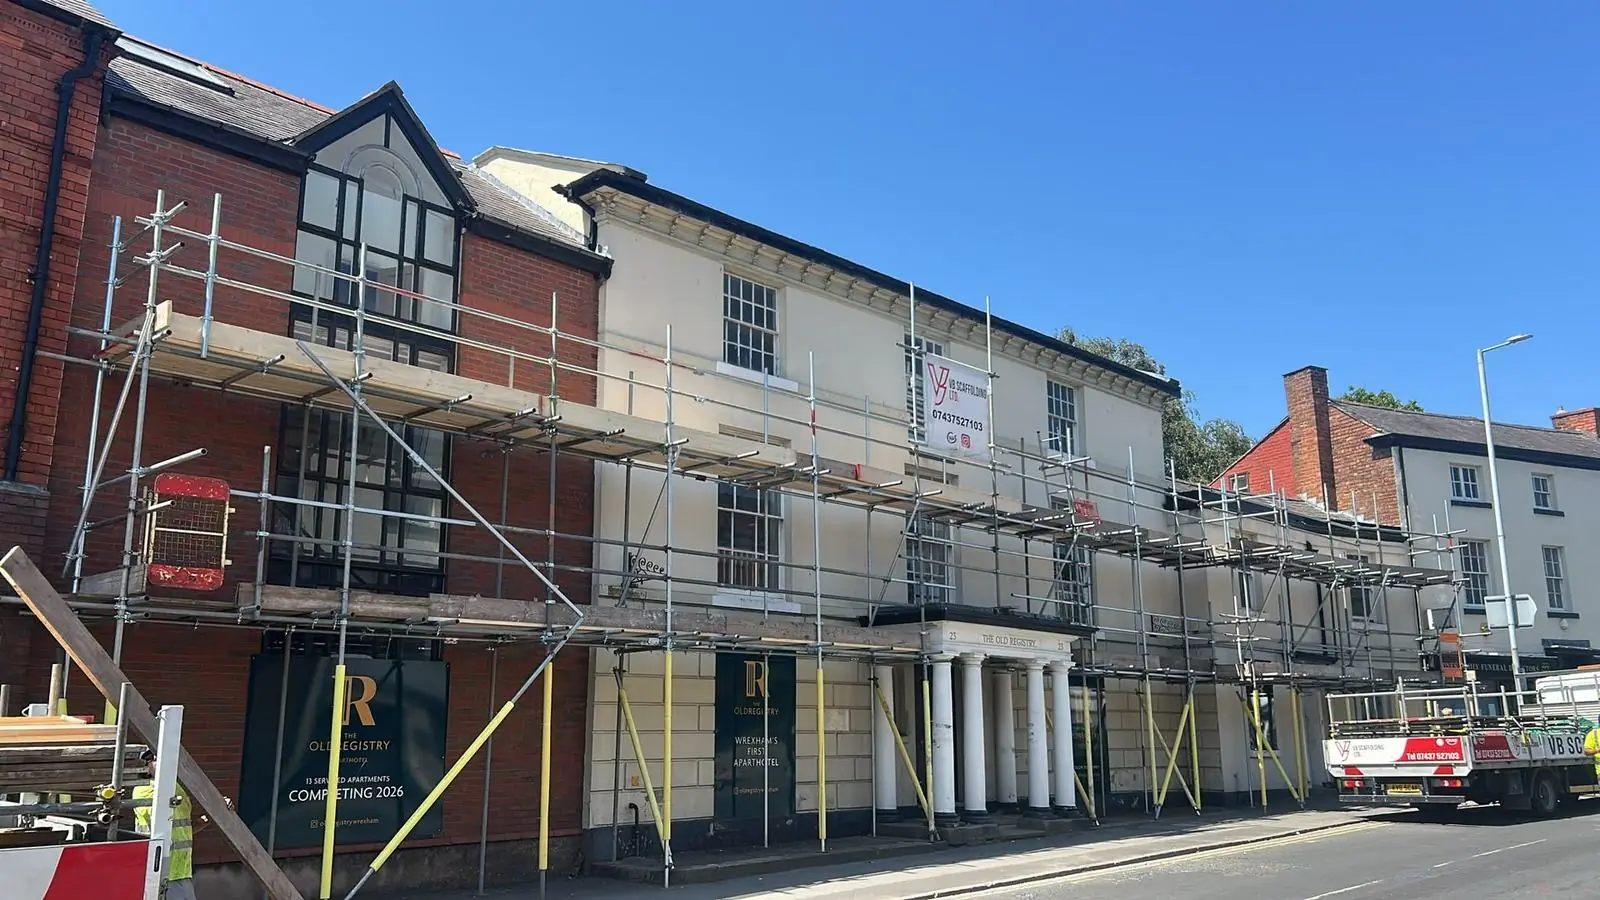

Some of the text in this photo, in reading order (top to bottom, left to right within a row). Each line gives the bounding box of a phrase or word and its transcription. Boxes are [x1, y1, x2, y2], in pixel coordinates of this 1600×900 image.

[956, 380, 987, 400] SCAFFOLDING
[932, 409, 983, 431] 07437527103
[949, 631, 957, 640] 23
[983, 634, 1036, 648] THE OLD REGISTRY
[1548, 736, 1564, 756] VB
[1416, 752, 1435, 761] 07437
[1436, 752, 1460, 760] 527103
[347, 775, 390, 783] APARTMENTS
[288, 785, 404, 802] COMPETING 2026
